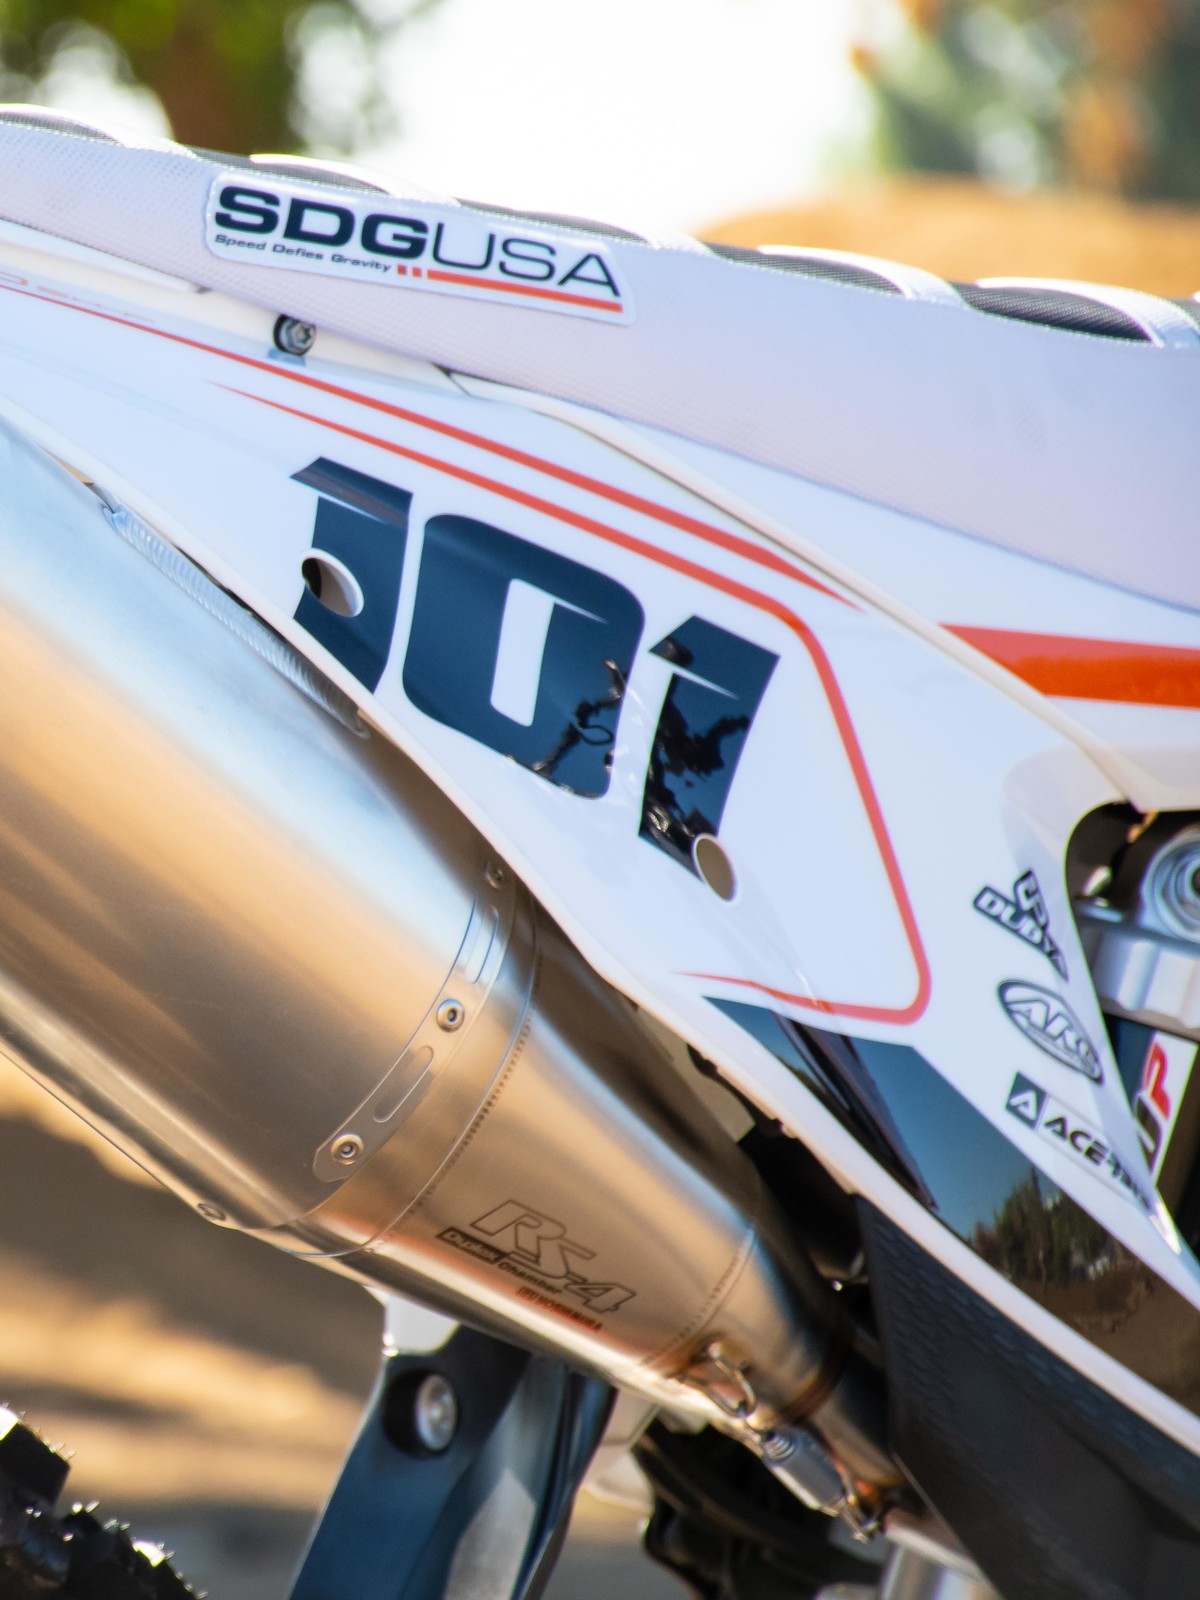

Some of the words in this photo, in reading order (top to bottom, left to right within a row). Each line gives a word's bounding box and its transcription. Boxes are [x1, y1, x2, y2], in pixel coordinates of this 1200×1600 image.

[214, 233, 267, 252] Speed
[272, 244, 324, 261] Defies
[331, 254, 391, 274] Gravity
[289, 456, 781, 884] 101
[497, 1261, 563, 1296] Chamber
